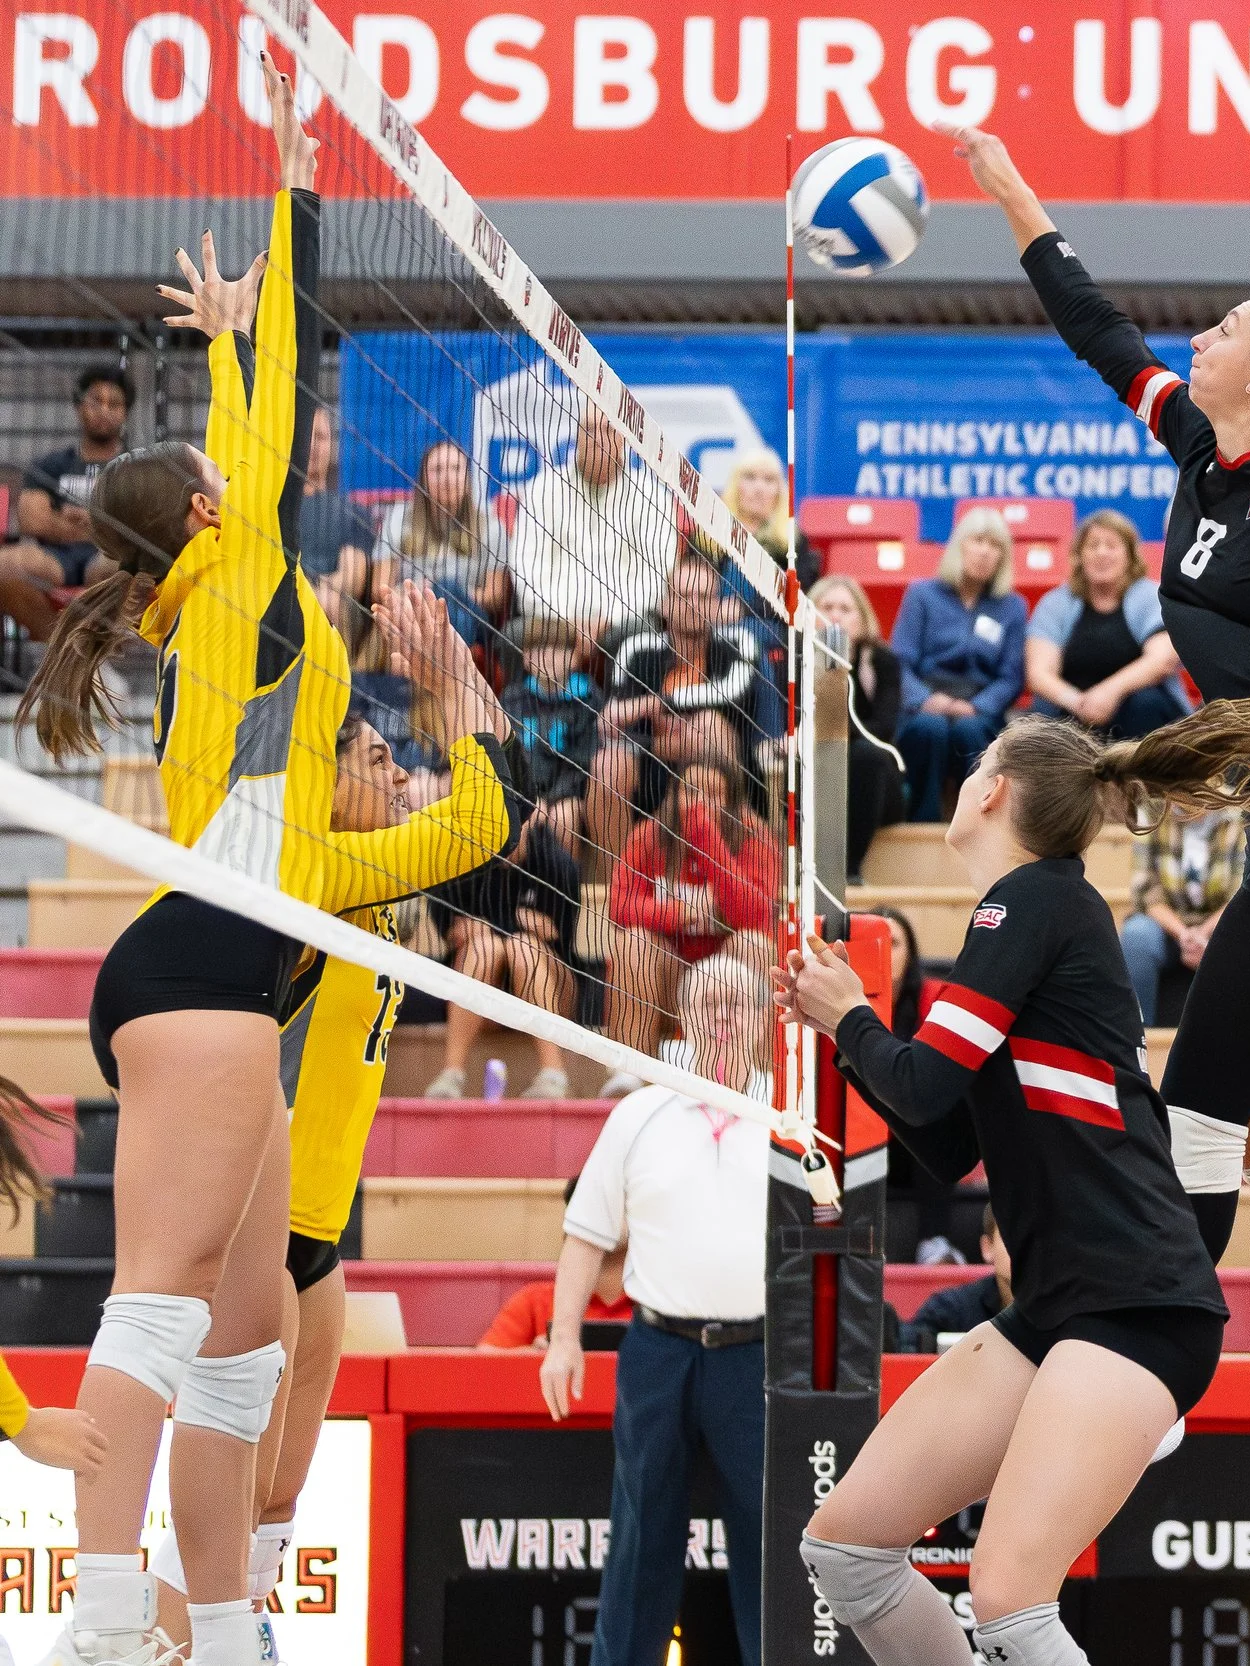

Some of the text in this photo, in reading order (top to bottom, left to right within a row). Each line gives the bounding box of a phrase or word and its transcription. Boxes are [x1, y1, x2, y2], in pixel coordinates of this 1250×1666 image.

[856, 421, 1139, 457] PENNSYLVANIA
[855, 462, 1028, 499] ATHLETIC
[1180, 517, 1227, 580] 8
